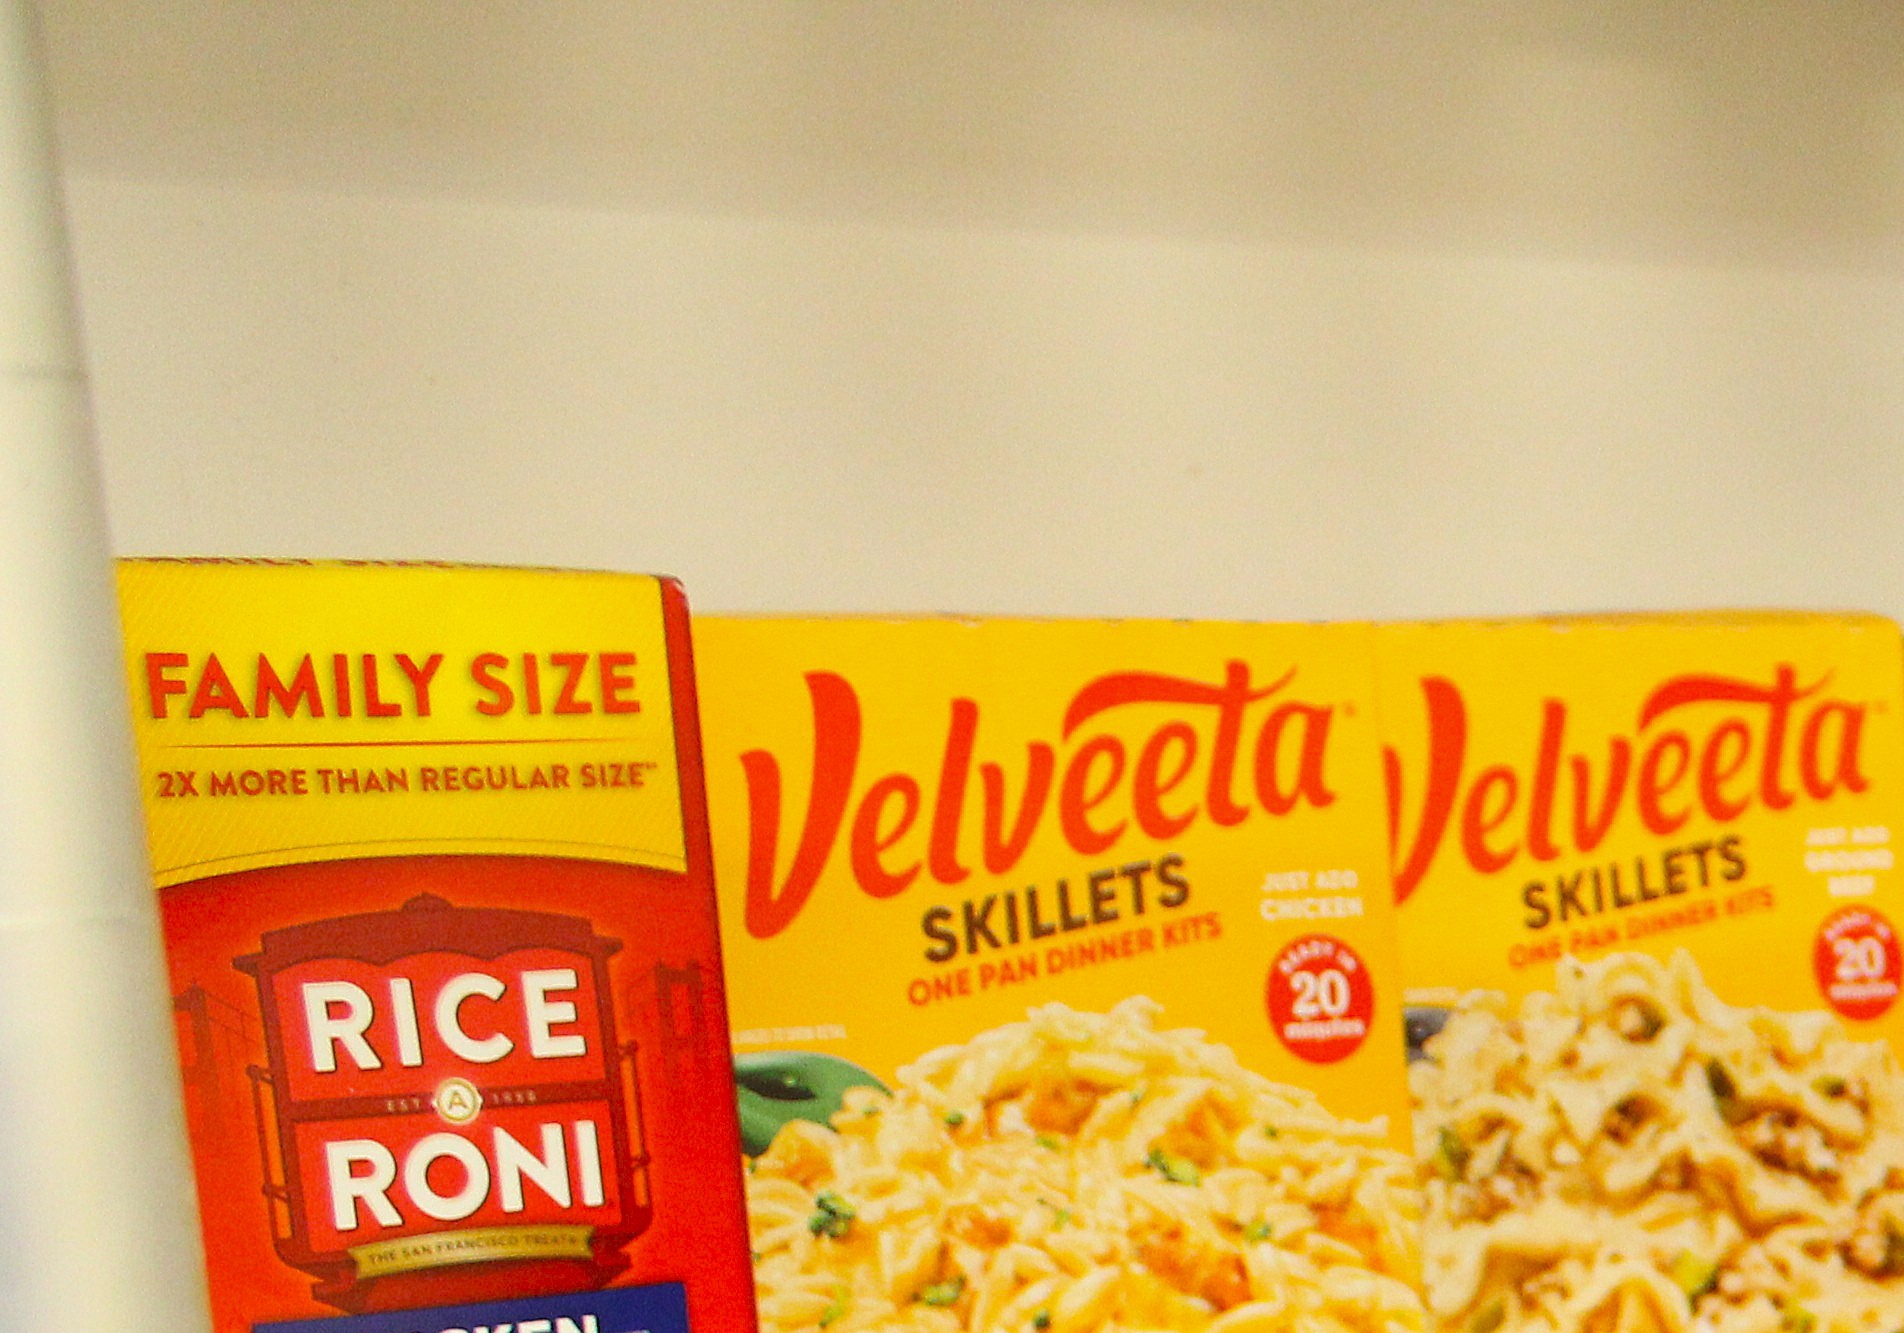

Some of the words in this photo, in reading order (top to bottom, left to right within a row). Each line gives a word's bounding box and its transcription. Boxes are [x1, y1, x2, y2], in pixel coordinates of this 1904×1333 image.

[145, 652, 443, 720] FAMILY
[471, 651, 641, 716] SIZE
[158, 770, 199, 799] 2X
[210, 768, 308, 797] MORE
[317, 766, 411, 794] THAN
[422, 763, 569, 792] REGULAR
[738, 659, 1336, 941] Velveeta
[1382, 661, 1869, 907] Velveeta
[921, 852, 1191, 964] SKILLETS
[1522, 834, 1748, 929] SKILLETS
[908, 967, 971, 1006] ONE
[979, 953, 1038, 990] PAN
[1046, 927, 1155, 975] DINNER
[1161, 911, 1222, 949] KITS
[1289, 968, 1351, 1018] 20
[1833, 936, 1887, 980] 20
[302, 968, 587, 1073] RICE
[325, 1119, 604, 1231] RONI
[368, 1249, 398, 1265] THE
[402, 1244, 433, 1258] SAN
[436, 1234, 521, 1254] FRANCISCO
